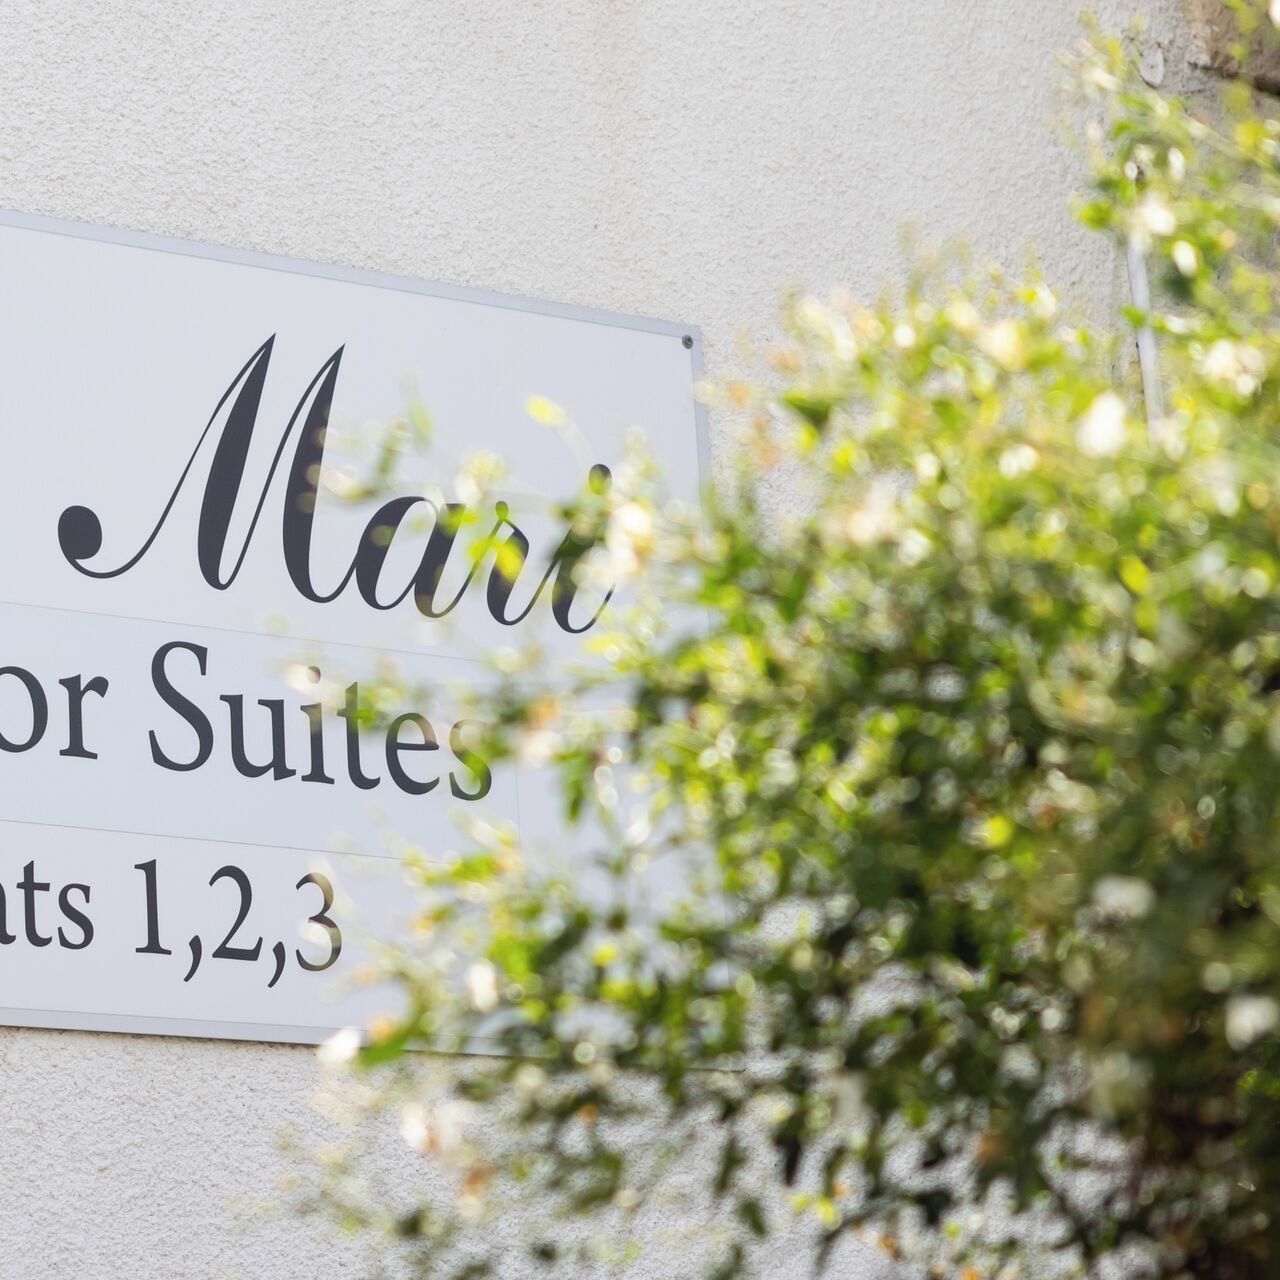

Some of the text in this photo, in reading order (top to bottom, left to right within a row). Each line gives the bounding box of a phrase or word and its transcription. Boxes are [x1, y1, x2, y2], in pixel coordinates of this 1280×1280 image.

[57, 332, 616, 634] Mari
[148, 640, 493, 802] Suites
[134, 858, 344, 989] 1,2,3
